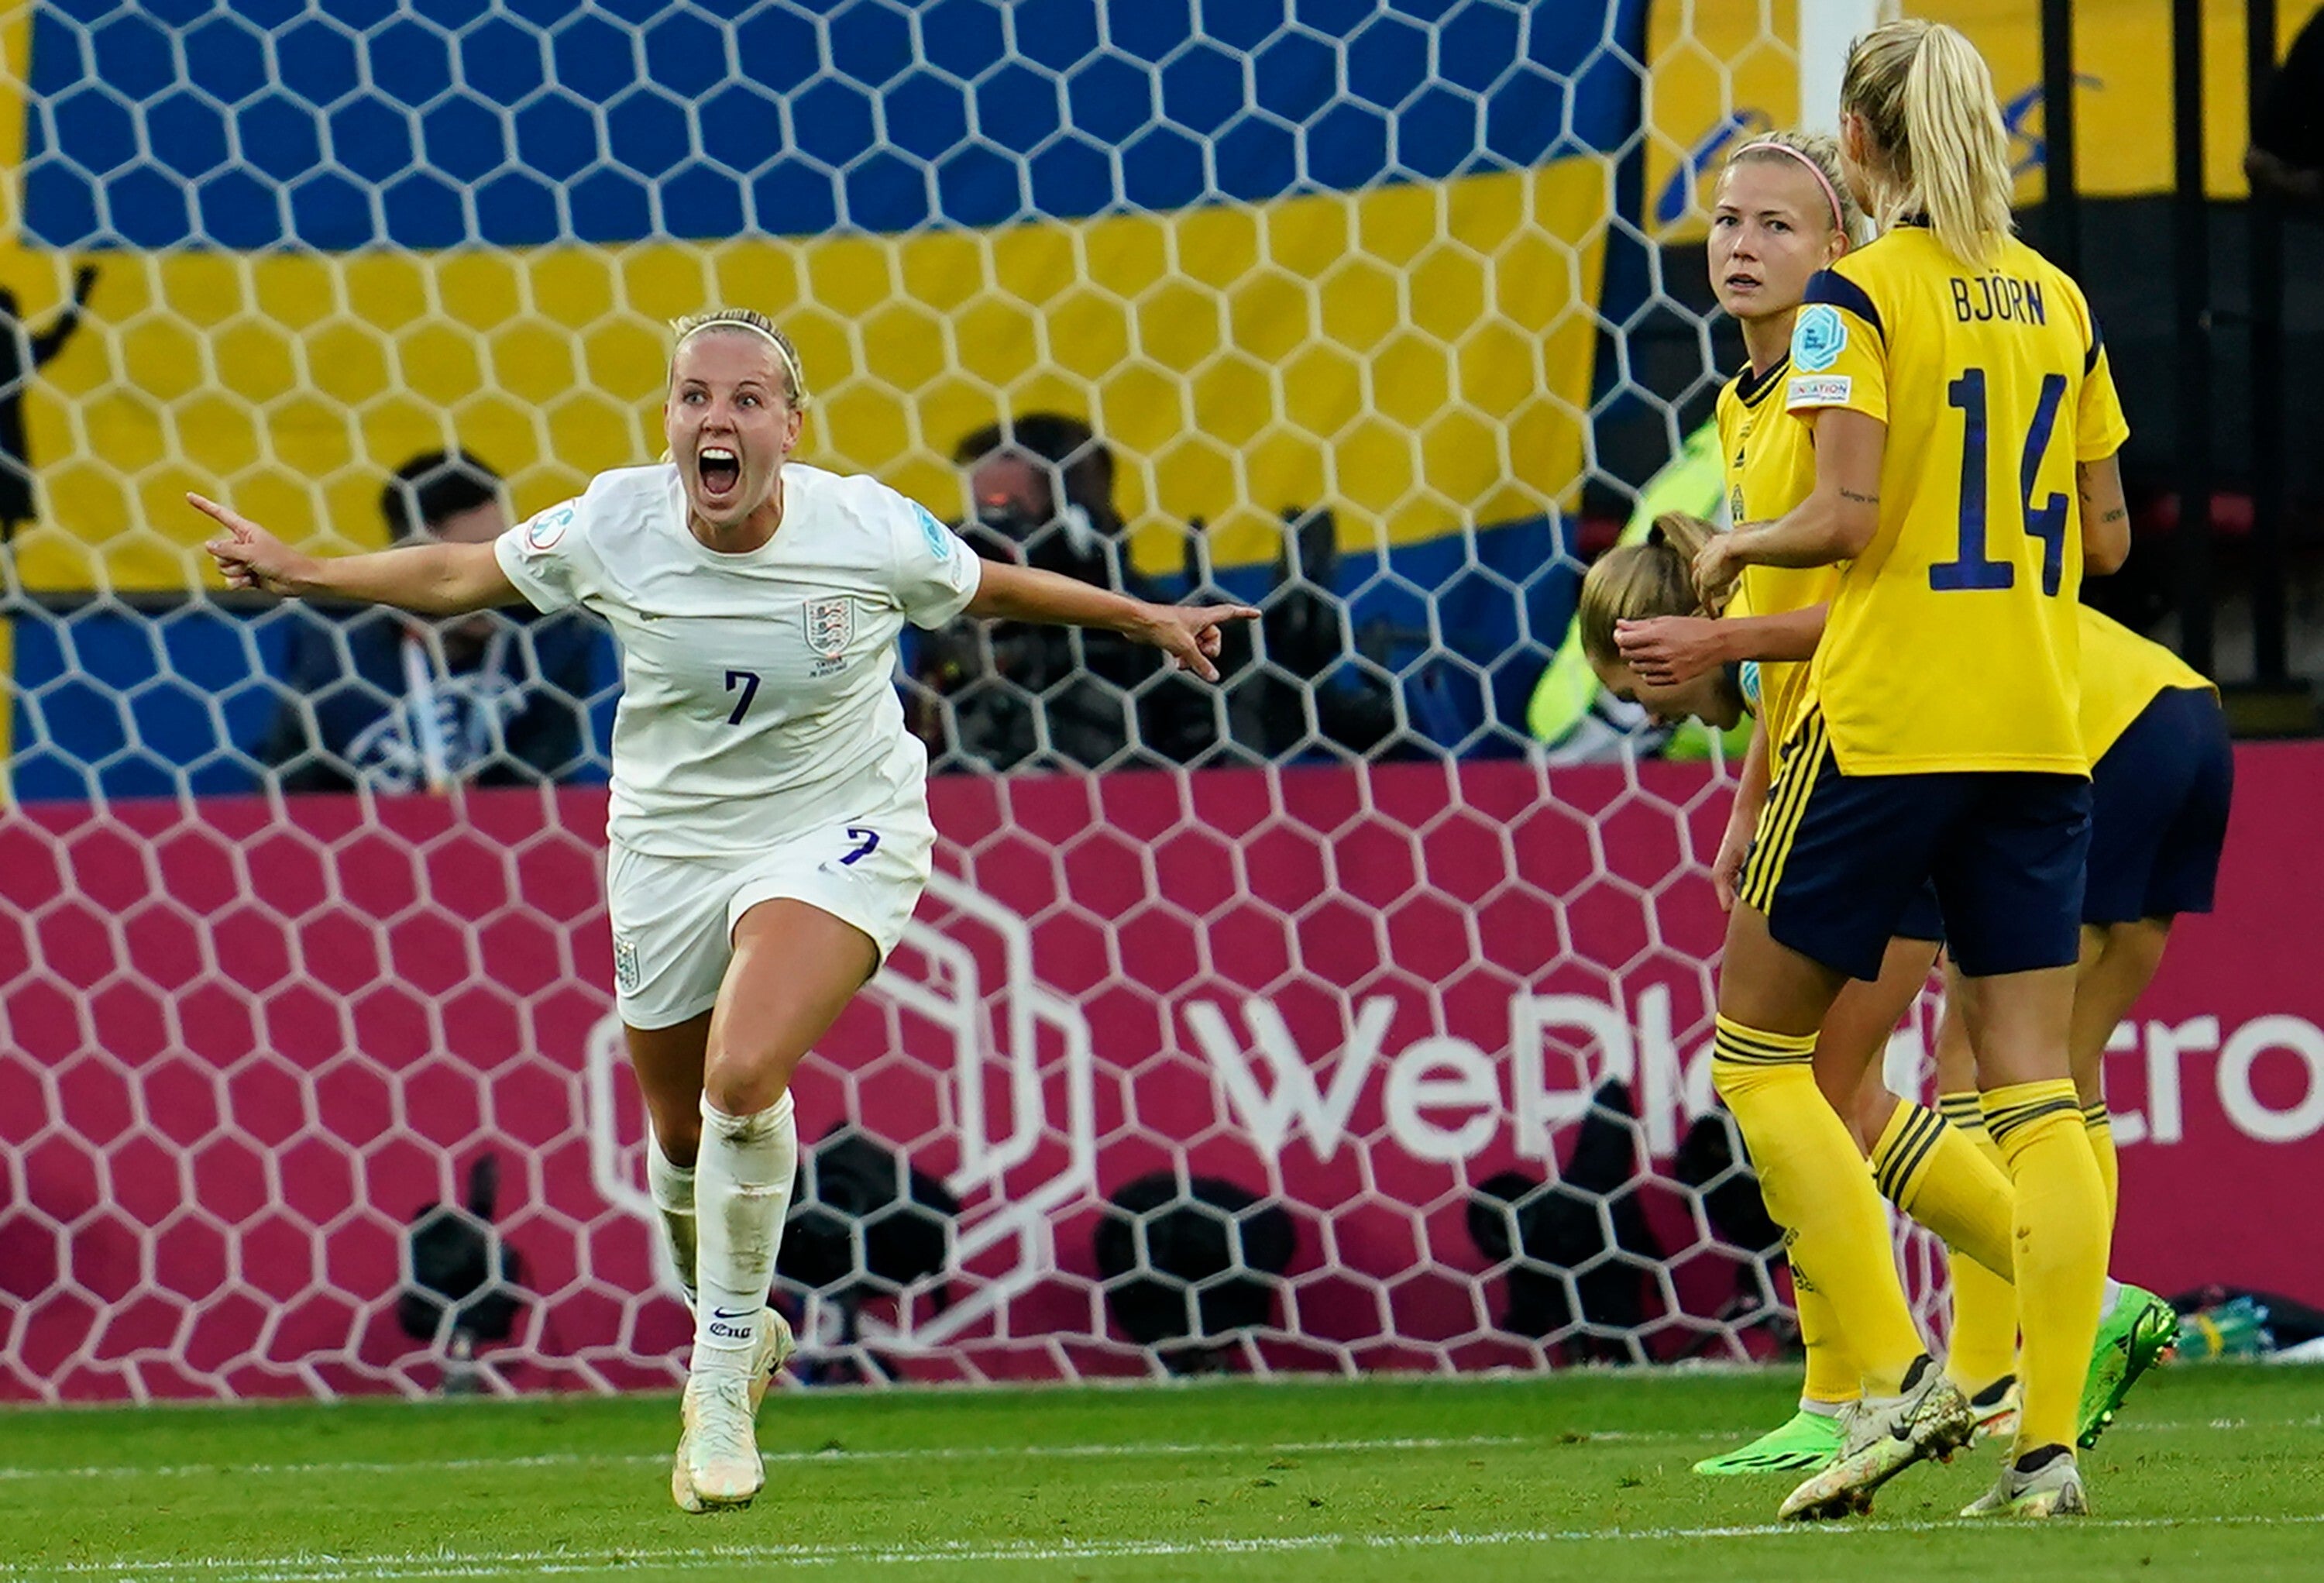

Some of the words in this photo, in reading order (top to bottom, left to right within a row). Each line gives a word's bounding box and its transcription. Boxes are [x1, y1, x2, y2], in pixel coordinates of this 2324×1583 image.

[1950, 268, 2046, 326] BJÖRN
[1929, 367, 2069, 597] 14
[725, 669, 761, 725] 7
[839, 828, 880, 865] 7
